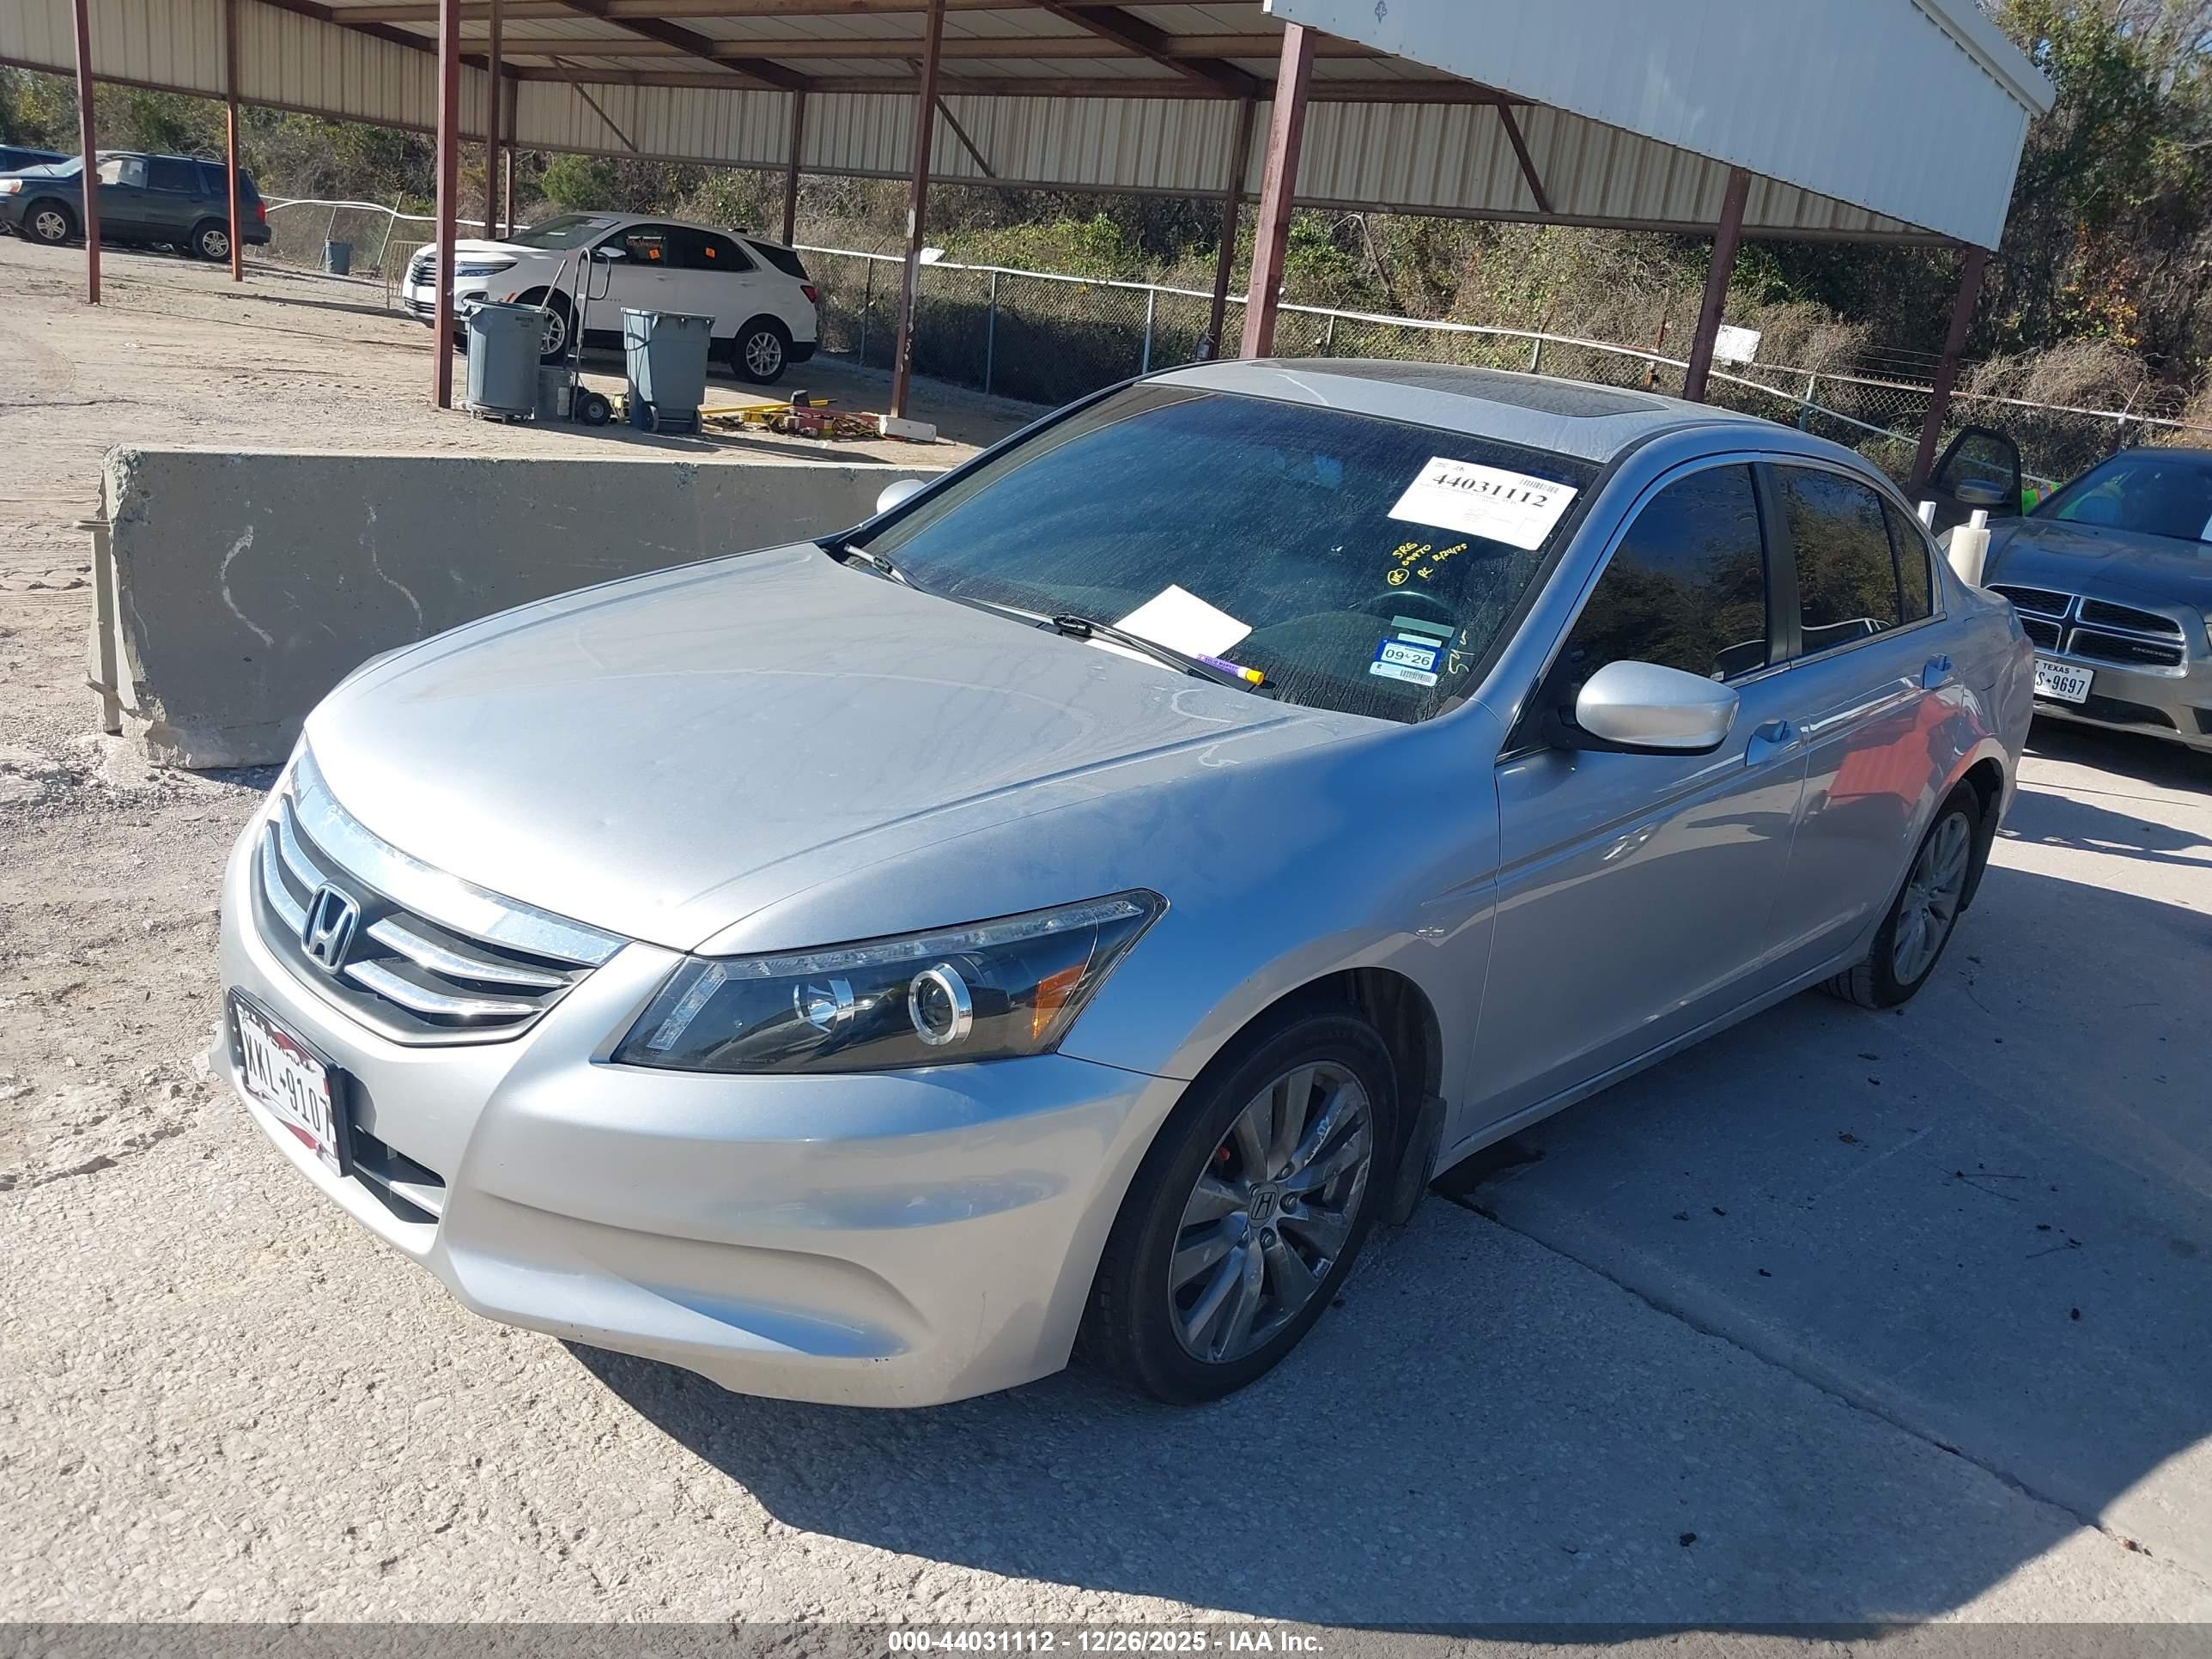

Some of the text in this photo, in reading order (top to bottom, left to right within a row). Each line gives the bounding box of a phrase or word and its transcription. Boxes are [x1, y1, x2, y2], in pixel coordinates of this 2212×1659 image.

[1432, 473, 1548, 507] 44031112
[1385, 649, 1431, 665] 09 26
[2043, 662, 2069, 674] TEXAS
[2051, 675, 2086, 696] 9697
[244, 1030, 280, 1096] XKL
[285, 1067, 332, 1142] 9107
